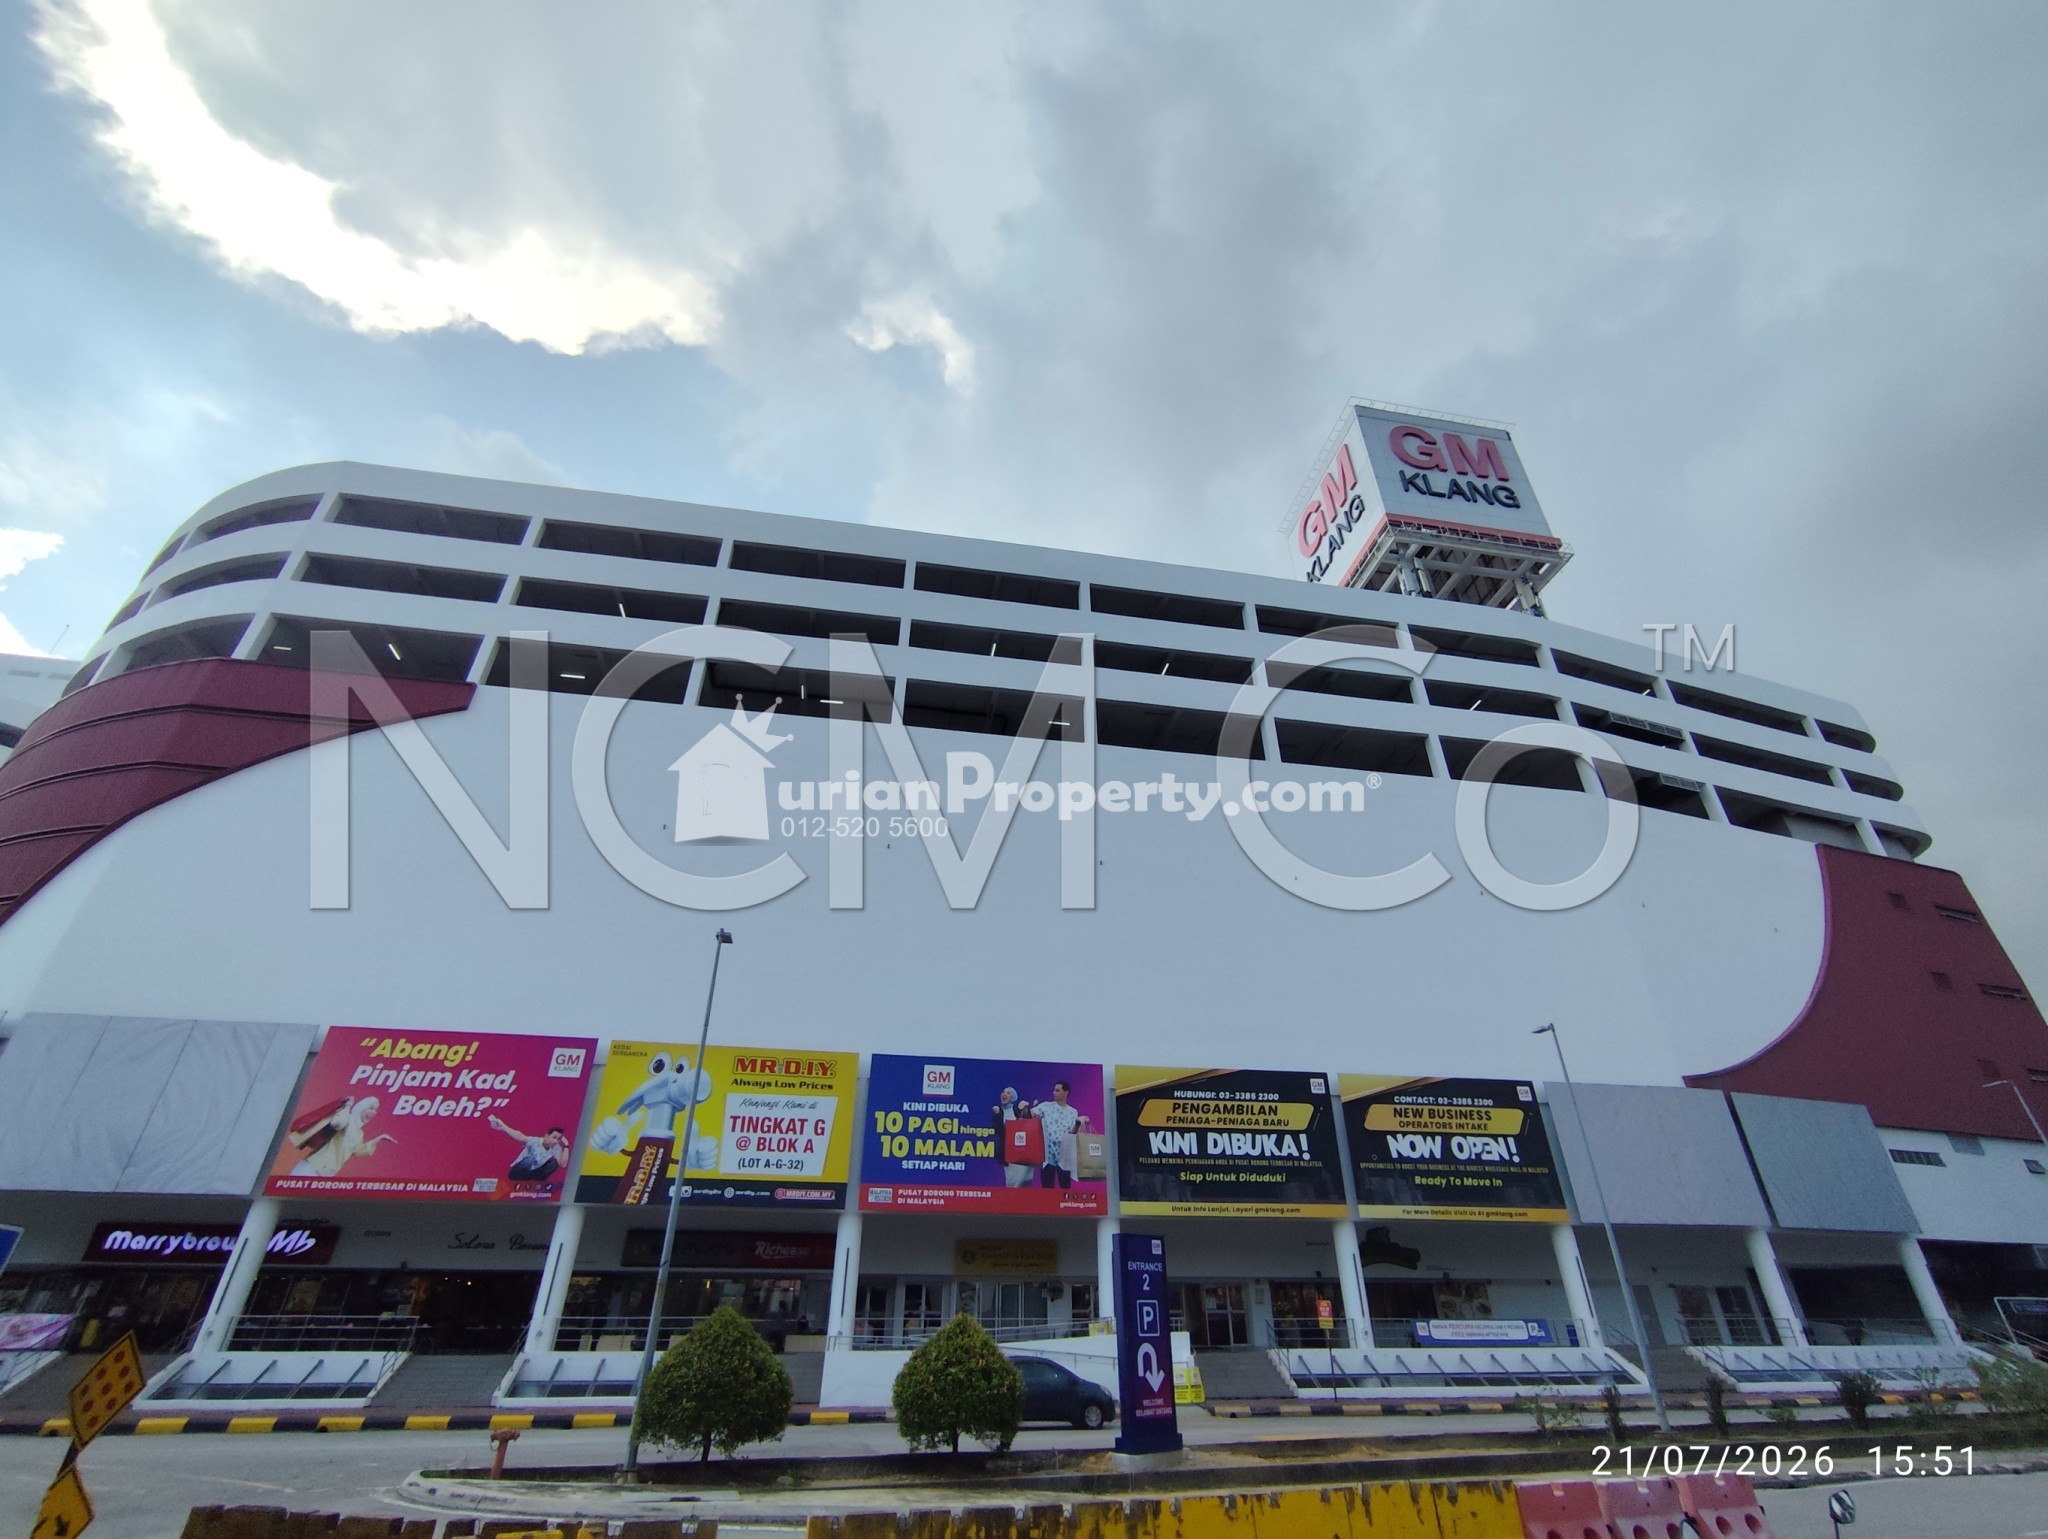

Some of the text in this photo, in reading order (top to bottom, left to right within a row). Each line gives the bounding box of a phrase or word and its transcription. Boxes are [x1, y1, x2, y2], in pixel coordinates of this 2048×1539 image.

[1389, 425, 1510, 482] GM
[1399, 470, 1521, 509] KLANG
[1298, 443, 1357, 558] GM
[1306, 494, 1365, 584] KLANG
[556, 1054, 580, 1066] GM
[350, 1065, 518, 1092] Pinjam Kad,
[927, 1071, 950, 1082] GM
[731, 1078, 834, 1090] Always Low Prices
[1174, 1090, 1217, 1099] HUBUNGI:
[1258, 1093, 1279, 1101] 2300
[1394, 1096, 1436, 1104] CONTACT:
[1474, 1098, 1493, 1106] 2300
[739, 1098, 818, 1110] Kunjungi Kami di
[903, 1102, 970, 1114] KINI DIBUKA
[1172, 1102, 1278, 1116] PENGAMBILAN
[1394, 1107, 1492, 1121] NEW BUSINESS
[730, 1115, 826, 1136] TINGKAT G
[875, 1111, 995, 1137] 10 PAGI hingga
[1166, 1116, 1290, 1126] PENIAGA-PENIAGA BARU
[1399, 1120, 1488, 1131] OPERATORS INTAKE
[736, 1136, 814, 1154] @ BLOK A
[881, 1135, 995, 1158] 10 MALAM
[1149, 1131, 1310, 1160] KINI DIBUKA!
[1386, 1134, 1520, 1163] NOW OPEN!
[738, 1158, 804, 1172] (LOT A-G-32)
[902, 1160, 965, 1171] SETIAP HARI
[1180, 1172, 1285, 1183] Siap Untuk Diduduki
[1415, 1175, 1502, 1188] Ready To Move In
[276, 1180, 310, 1188] PUSAT
[310, 1181, 354, 1190] BORONG
[356, 1182, 404, 1191] TERBESAR
[406, 1183, 416, 1191] DI
[418, 1184, 468, 1192] MALAYSIA
[786, 1190, 832, 1198] MRDIY.COM.MY
[923, 1189, 954, 1197] BORONG
[956, 1190, 991, 1198] TERBESAR
[755, 1241, 810, 1258] Richeese
[1128, 1261, 1163, 1272] ENTRANCE
[1142, 1274, 1150, 1291] 2
[1143, 1306, 1154, 1330] P
[1143, 1398, 1164, 1406] WELCOME
[1136, 1407, 1172, 1417] SELAMAT DATANG
